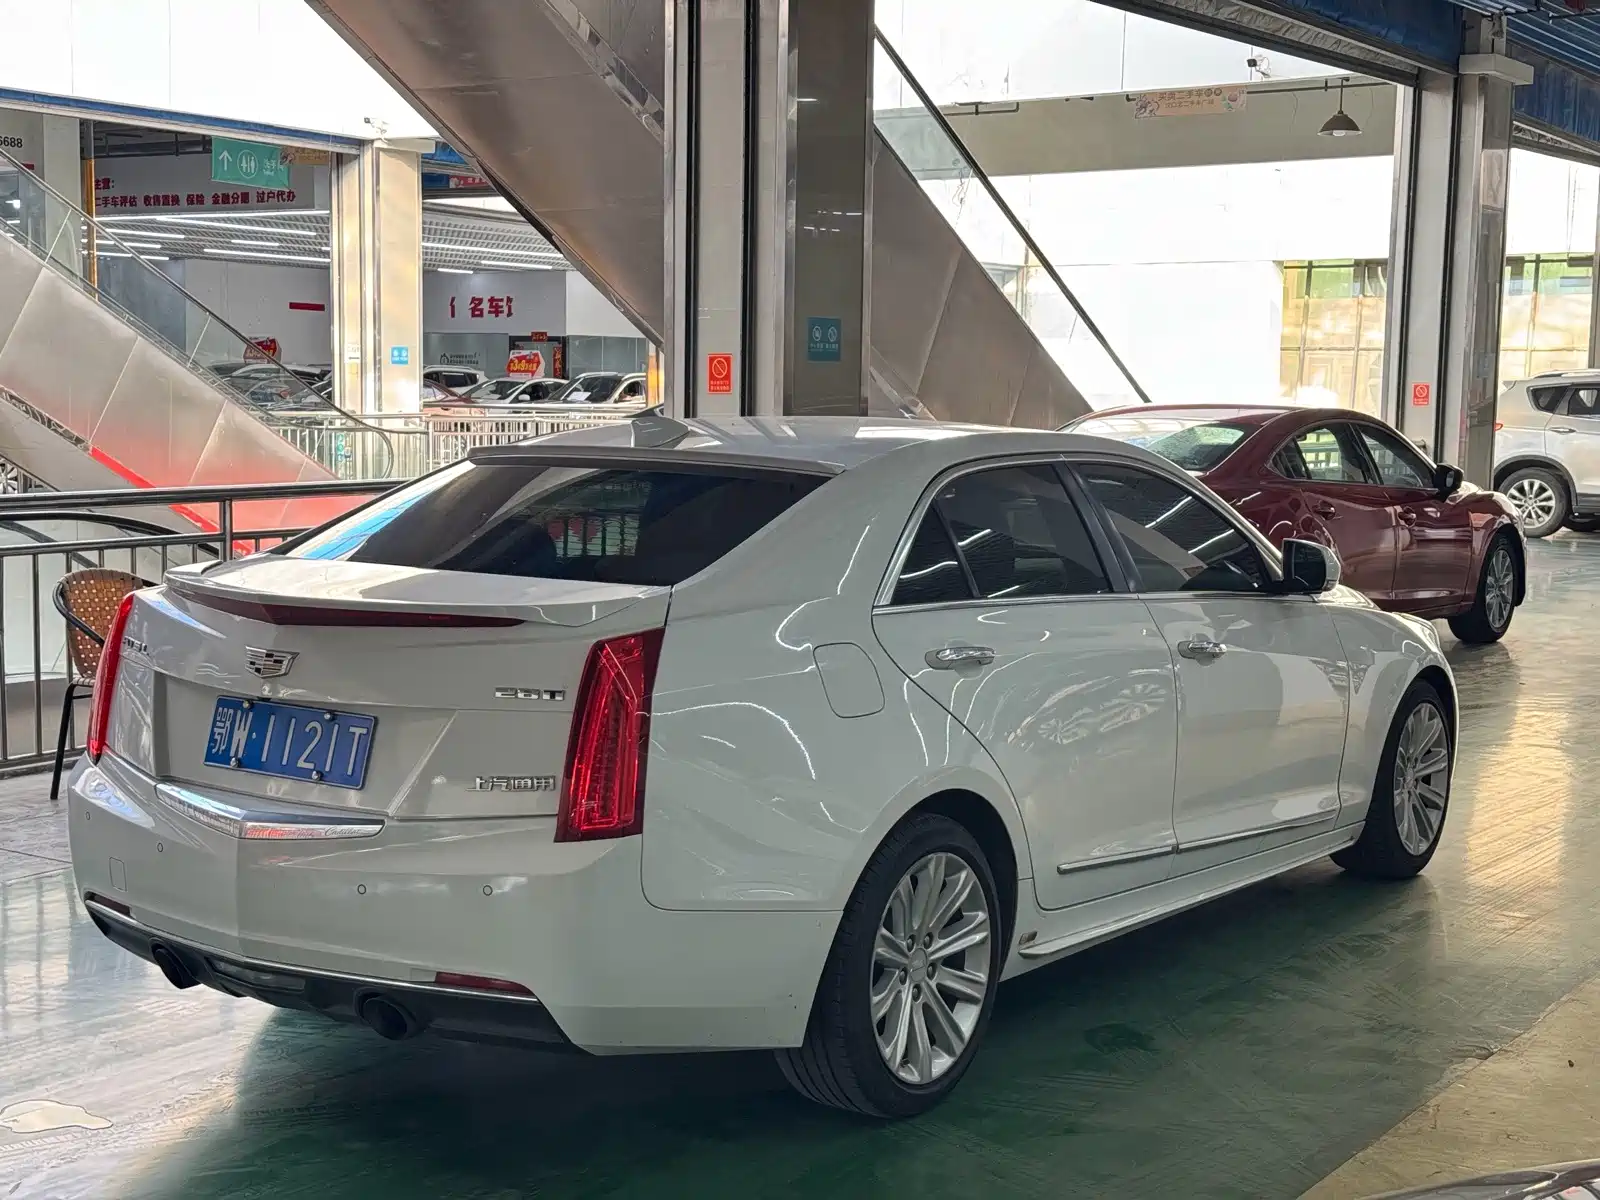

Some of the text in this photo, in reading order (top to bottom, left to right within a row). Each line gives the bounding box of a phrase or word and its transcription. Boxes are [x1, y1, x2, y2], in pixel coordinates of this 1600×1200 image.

[95, 194, 138, 207] 二手车评估
[186, 193, 205, 206] 保险
[256, 189, 297, 204] 过户代办
[466, 775, 557, 792] 上汽通用
